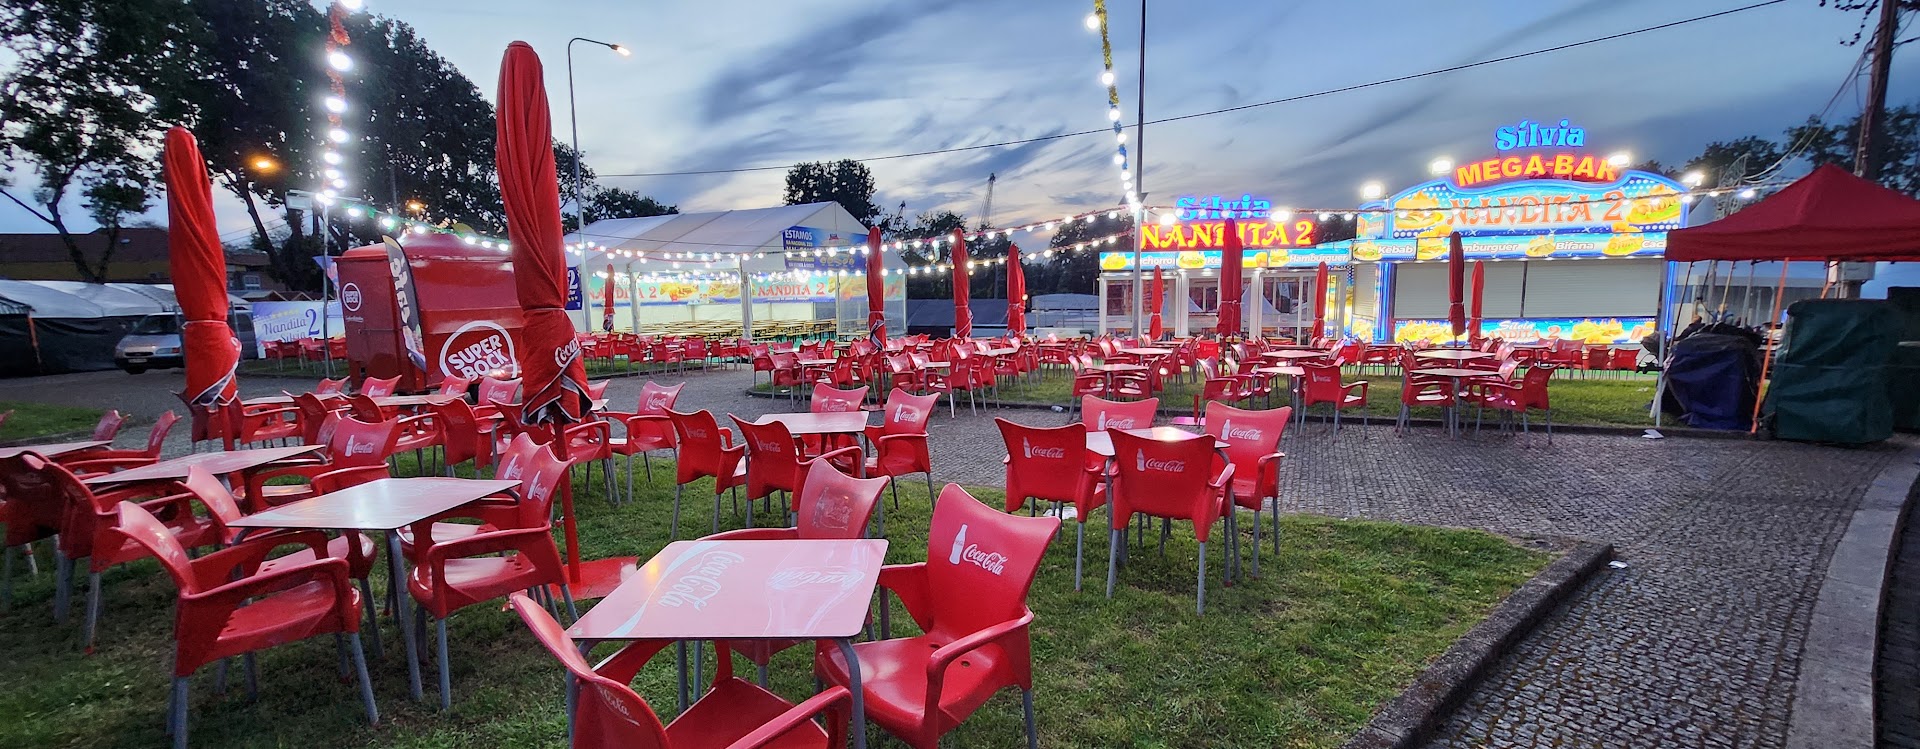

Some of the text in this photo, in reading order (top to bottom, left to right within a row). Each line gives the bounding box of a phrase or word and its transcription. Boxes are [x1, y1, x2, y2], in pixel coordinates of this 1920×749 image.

[1496, 119, 1585, 150] Sílvia
[1456, 154, 1618, 187] MEGA-BAR
[1447, 191, 1625, 226] NANDITA 2
[785, 229, 813, 241] ESTAMOS
[1295, 221, 1315, 246] 2
[1377, 245, 1414, 254] Kebab
[1555, 241, 1595, 251] Bifana
[1289, 253, 1349, 265] Hamburguer
[648, 286, 657, 299] 2
[758, 282, 826, 297] NANDITA 2
[263, 308, 320, 336] Nandita 2
[1548, 326, 1562, 339] 2
[448, 334, 503, 370] SUPER
[460, 348, 509, 382] BOCK
